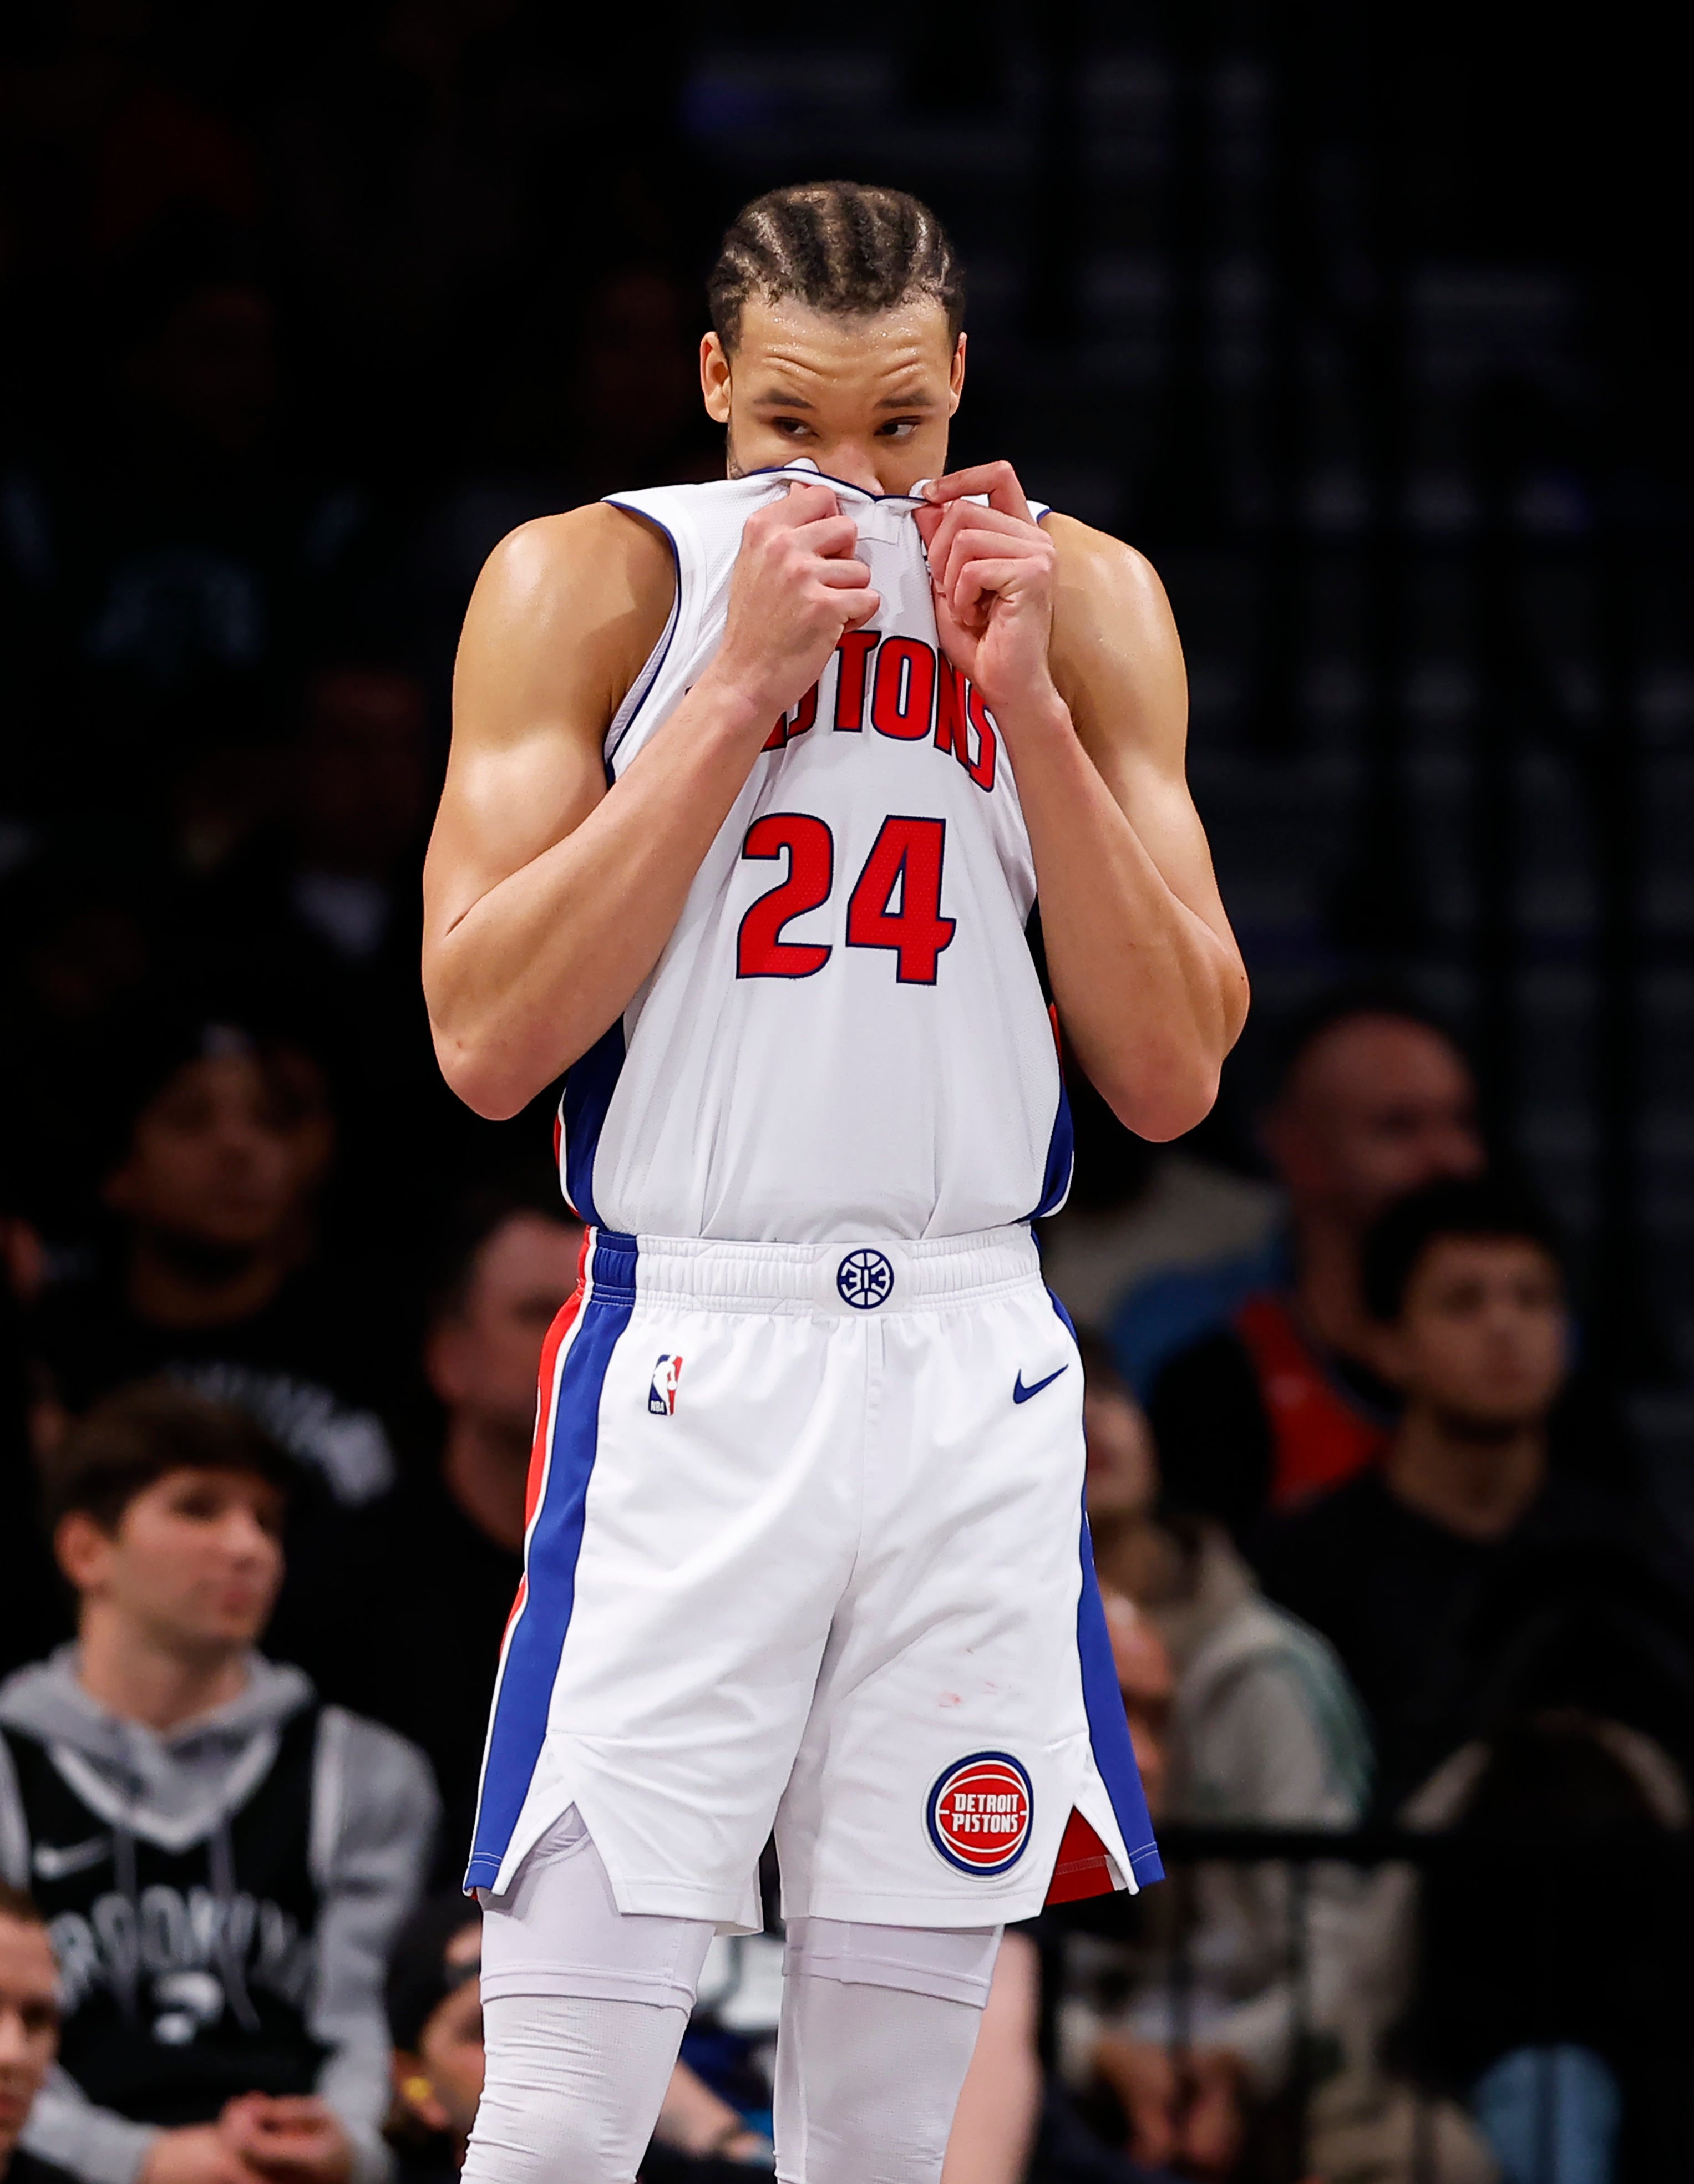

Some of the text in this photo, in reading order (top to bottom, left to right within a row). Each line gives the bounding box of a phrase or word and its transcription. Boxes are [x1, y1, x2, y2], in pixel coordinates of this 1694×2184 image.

[736, 812, 956, 986] 24
[953, 1793, 1019, 1812] DETROIT
[951, 1813, 1018, 1833] PISTONS
